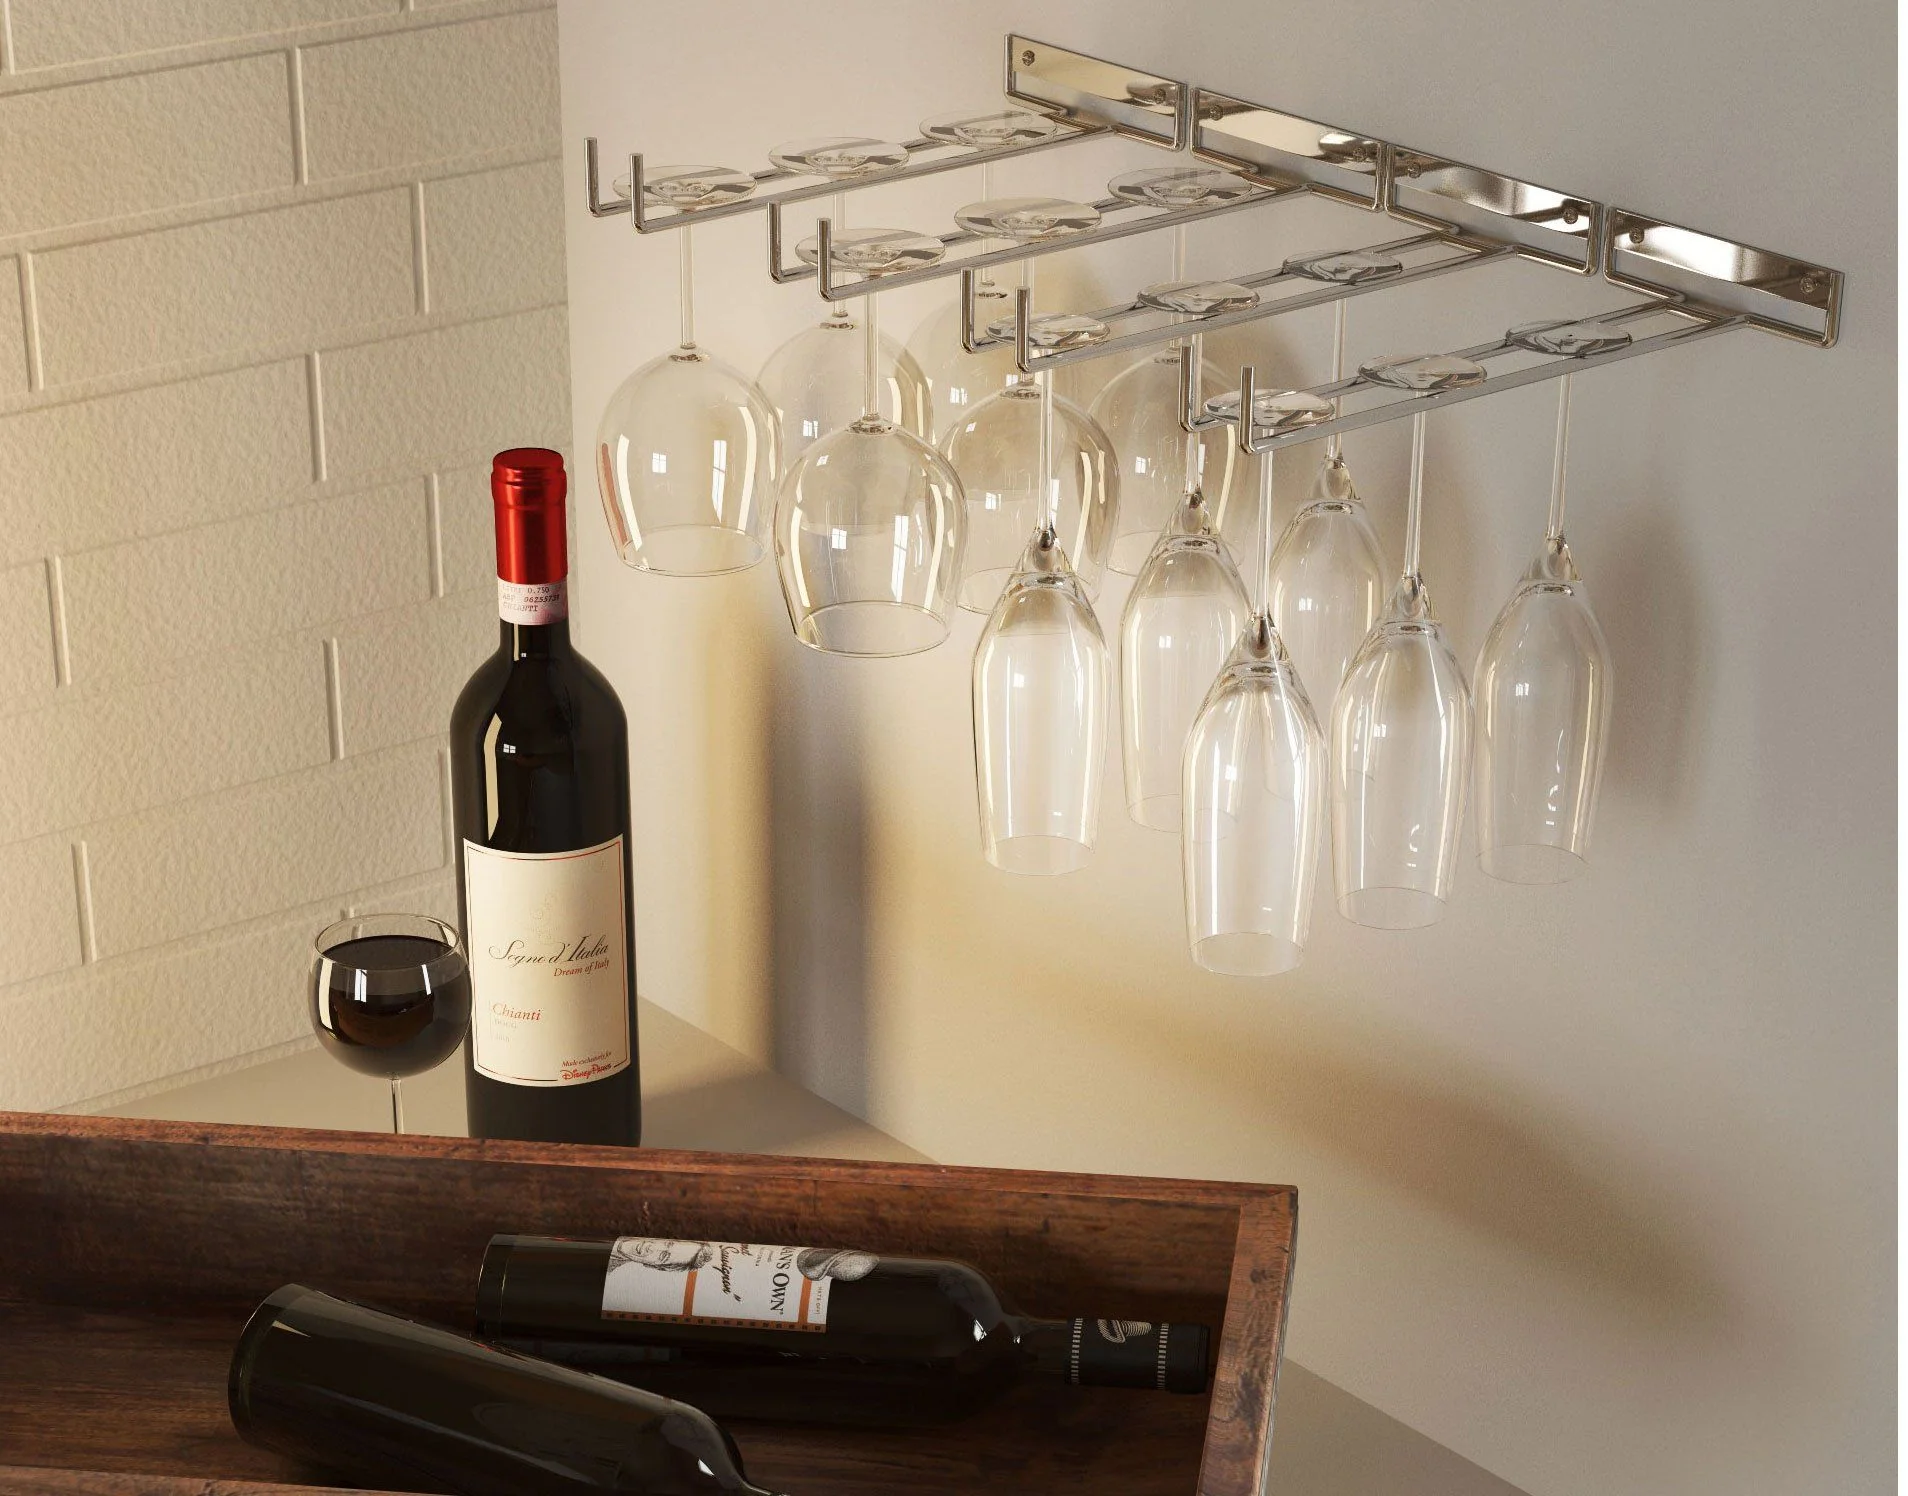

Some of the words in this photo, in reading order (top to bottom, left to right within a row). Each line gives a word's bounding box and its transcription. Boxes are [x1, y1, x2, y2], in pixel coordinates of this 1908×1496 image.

[554, 966, 582, 977] Dream
[584, 963, 594, 975] of
[595, 959, 609, 970] Italy
[492, 1002, 542, 1021] Chianti
